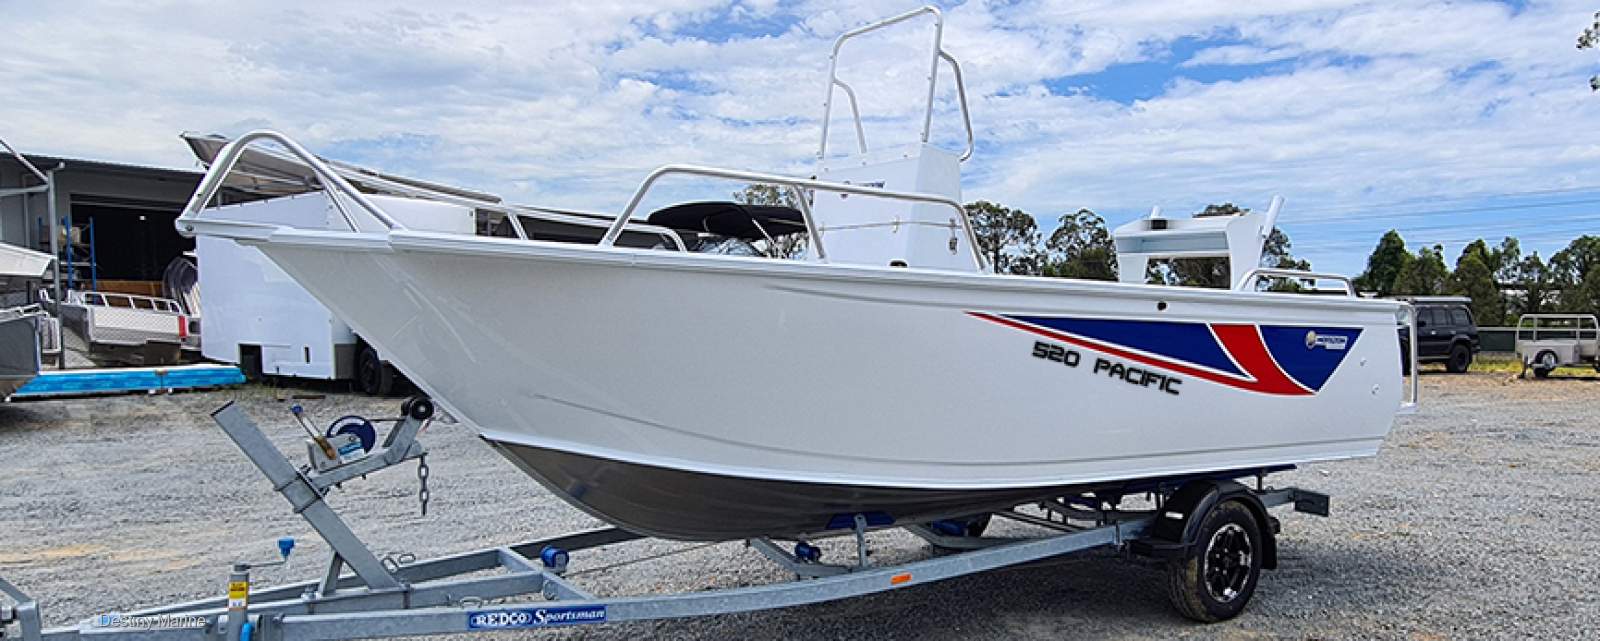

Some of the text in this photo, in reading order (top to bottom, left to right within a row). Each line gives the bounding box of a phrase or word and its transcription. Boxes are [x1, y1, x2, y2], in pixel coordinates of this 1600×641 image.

[1032, 341, 1183, 395] 520 PACIFIC
[475, 609, 605, 627] REDCO Sportsman
